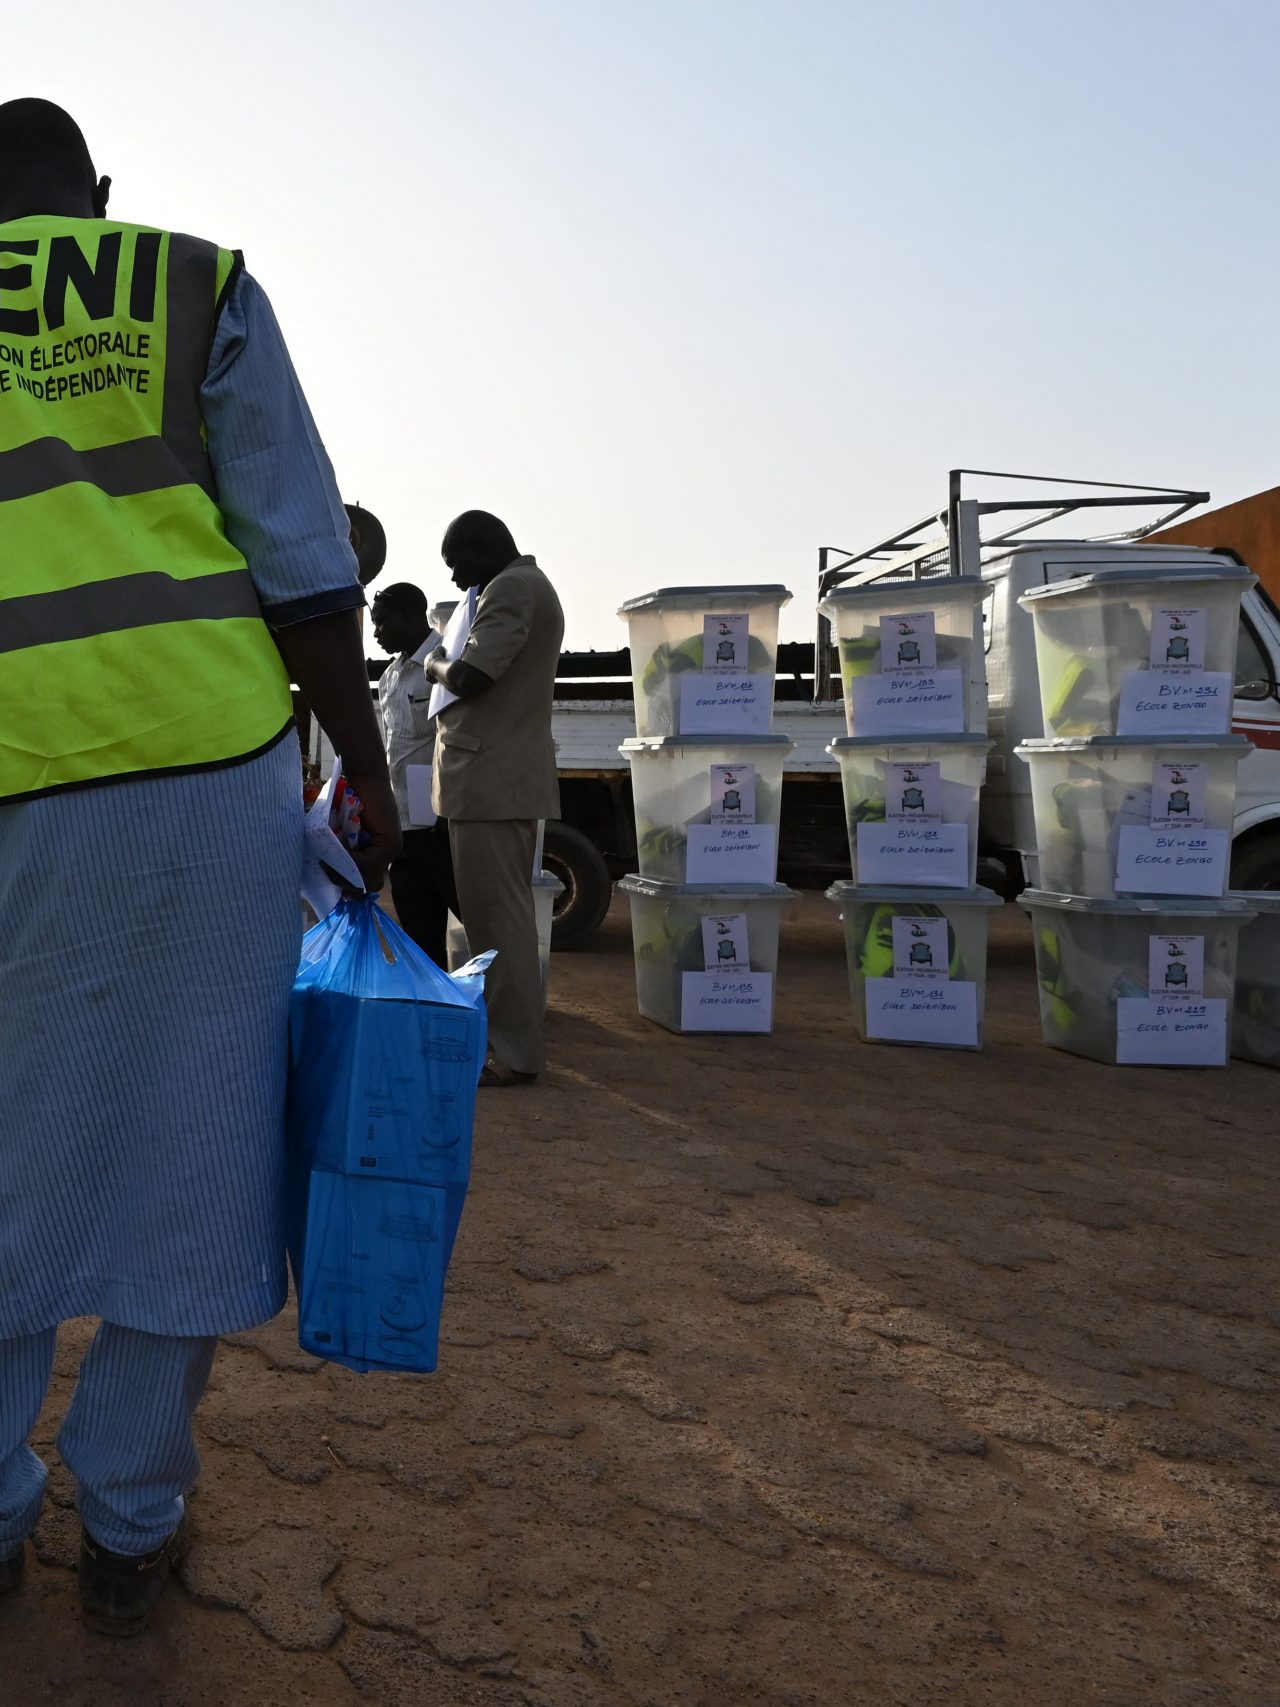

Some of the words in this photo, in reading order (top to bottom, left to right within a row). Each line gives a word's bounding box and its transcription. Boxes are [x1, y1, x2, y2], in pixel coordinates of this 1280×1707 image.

[30, 331, 150, 372] ÉLECTORALE
[16, 363, 149, 402] INDÉPENDANTE
[1136, 702, 1167, 711] ECOLE
[1135, 854, 1171, 864] ECOLE
